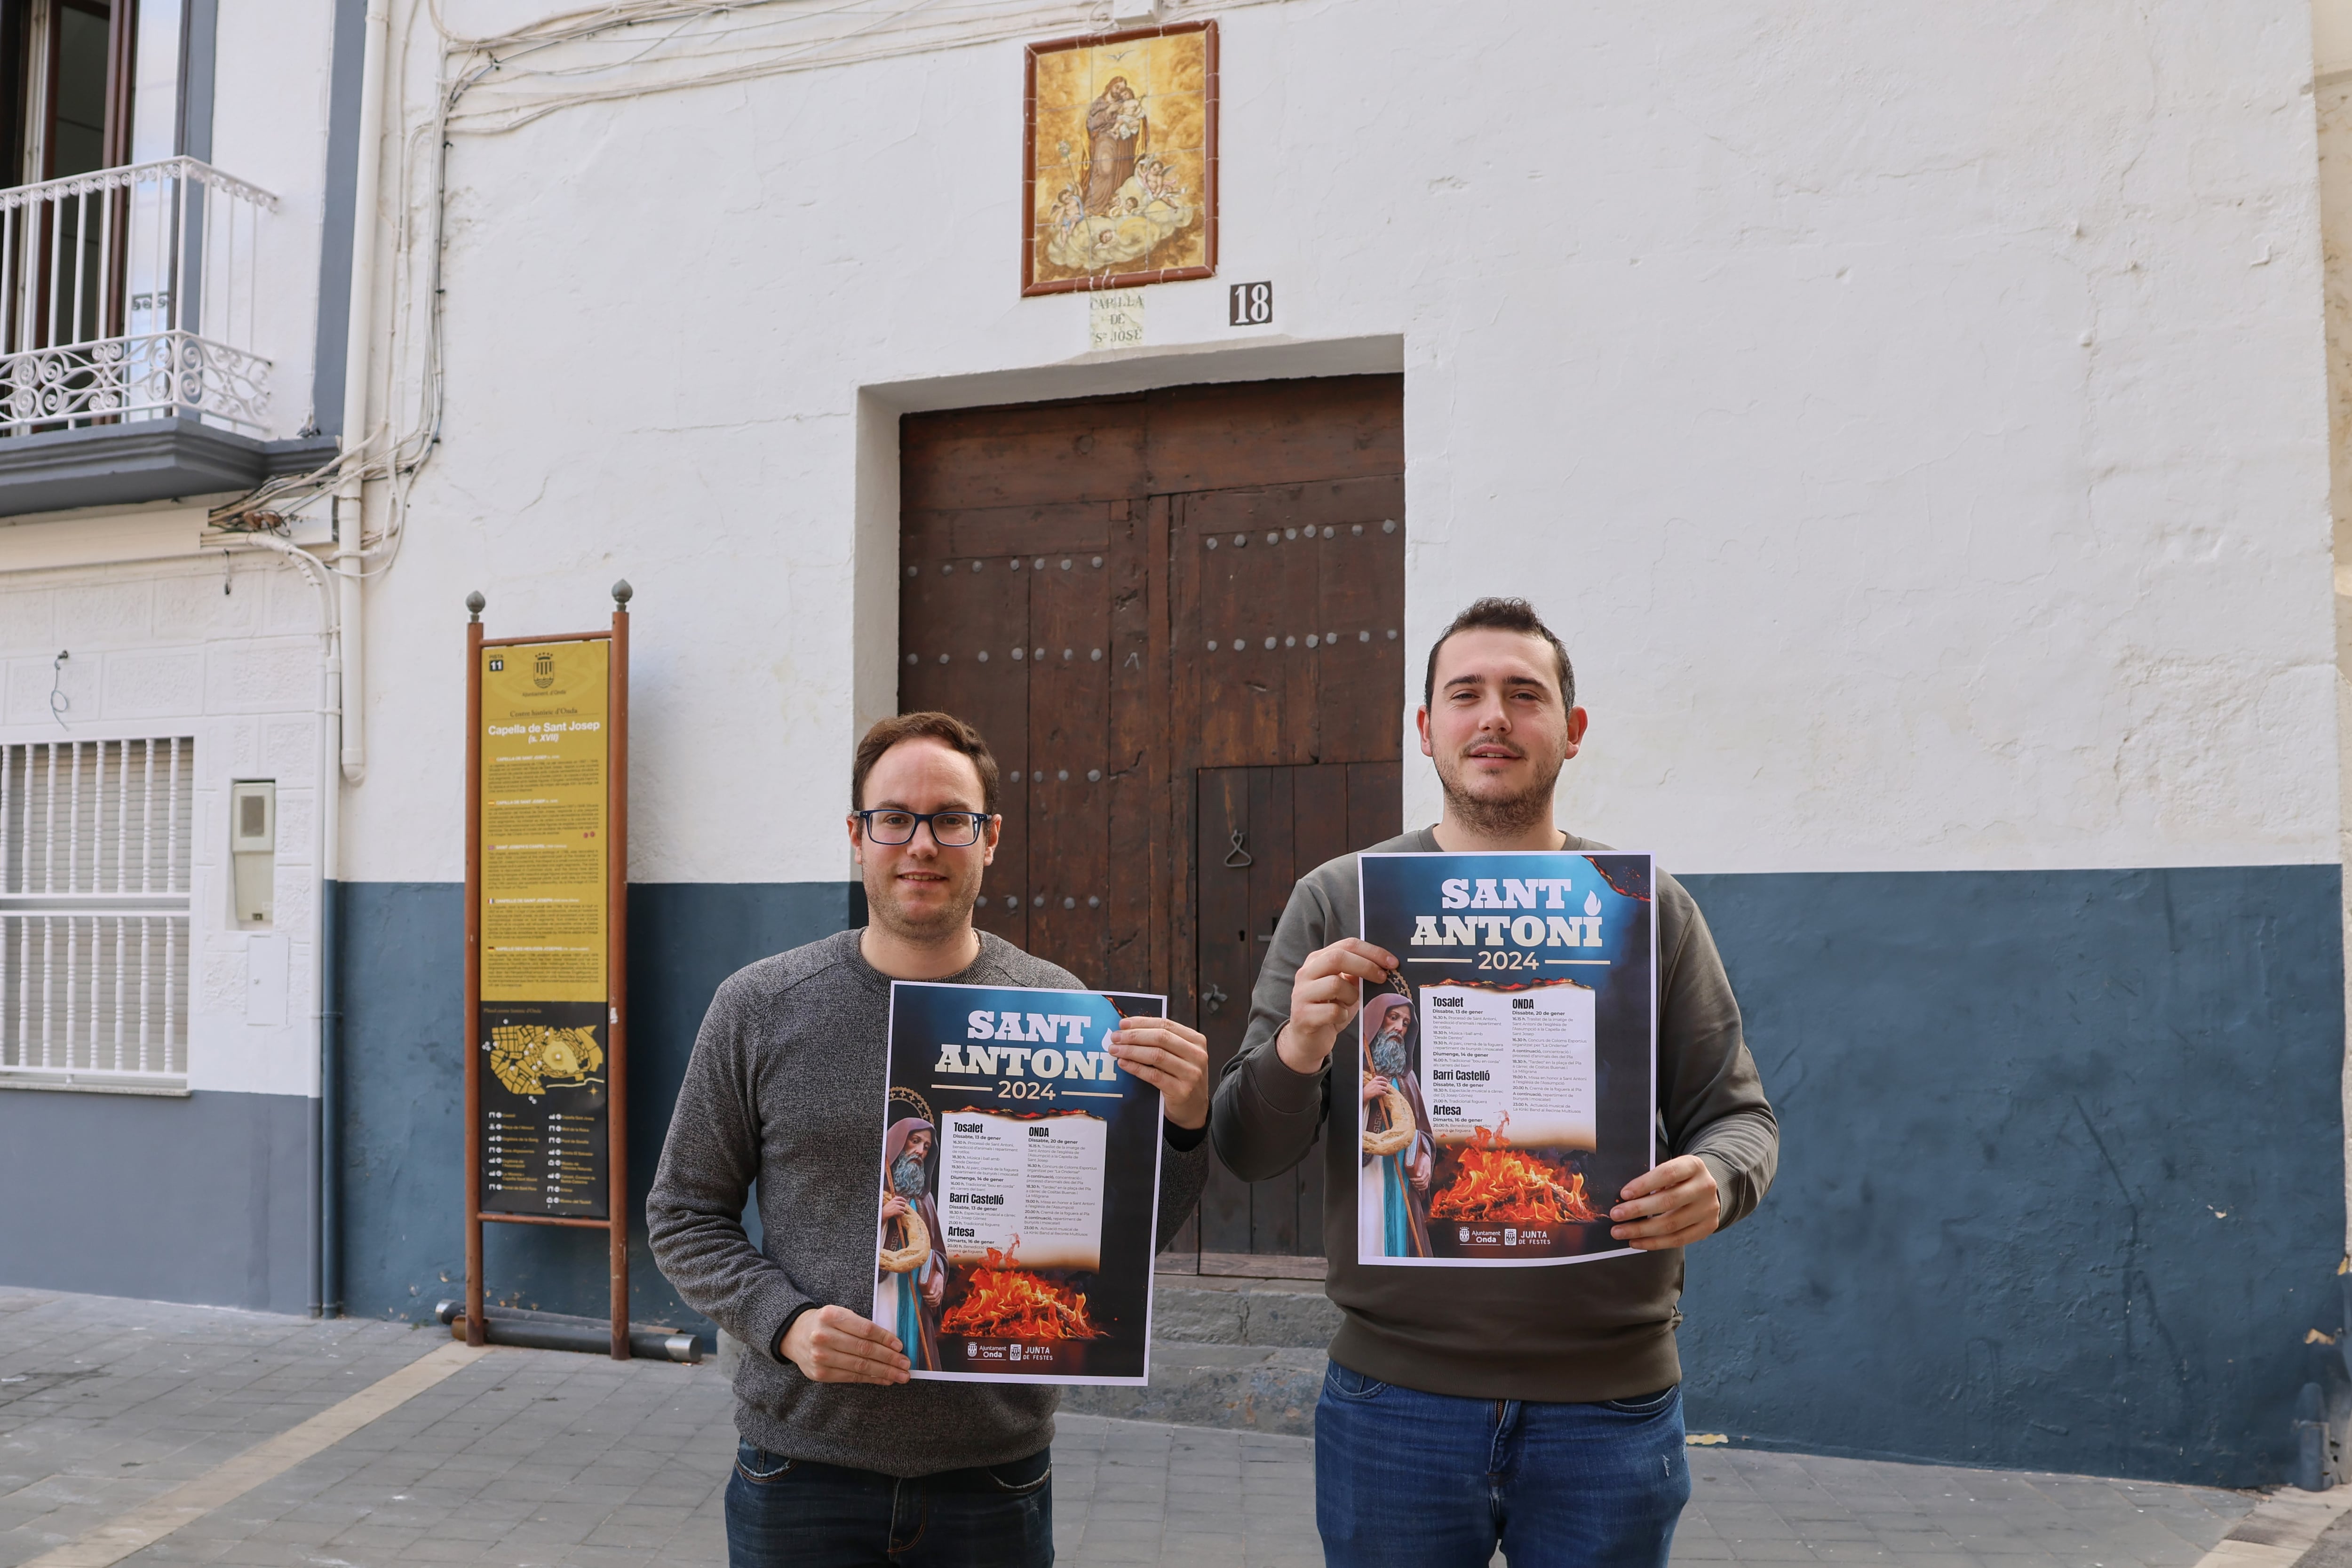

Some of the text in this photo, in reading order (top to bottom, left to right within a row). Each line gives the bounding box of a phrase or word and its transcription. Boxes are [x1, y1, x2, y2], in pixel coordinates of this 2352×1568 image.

[1235, 284, 1269, 324] 18
[1111, 313, 1125, 324] DE
[491, 661, 502, 670] 11
[488, 721, 600, 736] Capella de Sant Josep
[1442, 878, 1571, 909] SANT
[1411, 915, 1603, 947] ANTONI
[1478, 951, 1539, 970] 2024
[1433, 996, 1463, 1007] Tosalet
[1512, 999, 1534, 1009] ONDA
[968, 1010, 1091, 1044] SANT
[934, 1044, 1117, 1081] ANTONI
[1433, 1069, 1489, 1081] Barri Castelló
[998, 1080, 1056, 1101] 2024
[1433, 1105, 1461, 1115] Artesa
[954, 1122, 983, 1132] Tosalet
[1029, 1127, 1049, 1137] ONDA
[950, 1193, 1003, 1204] Barri Castelló
[948, 1226, 974, 1237] Artesa
